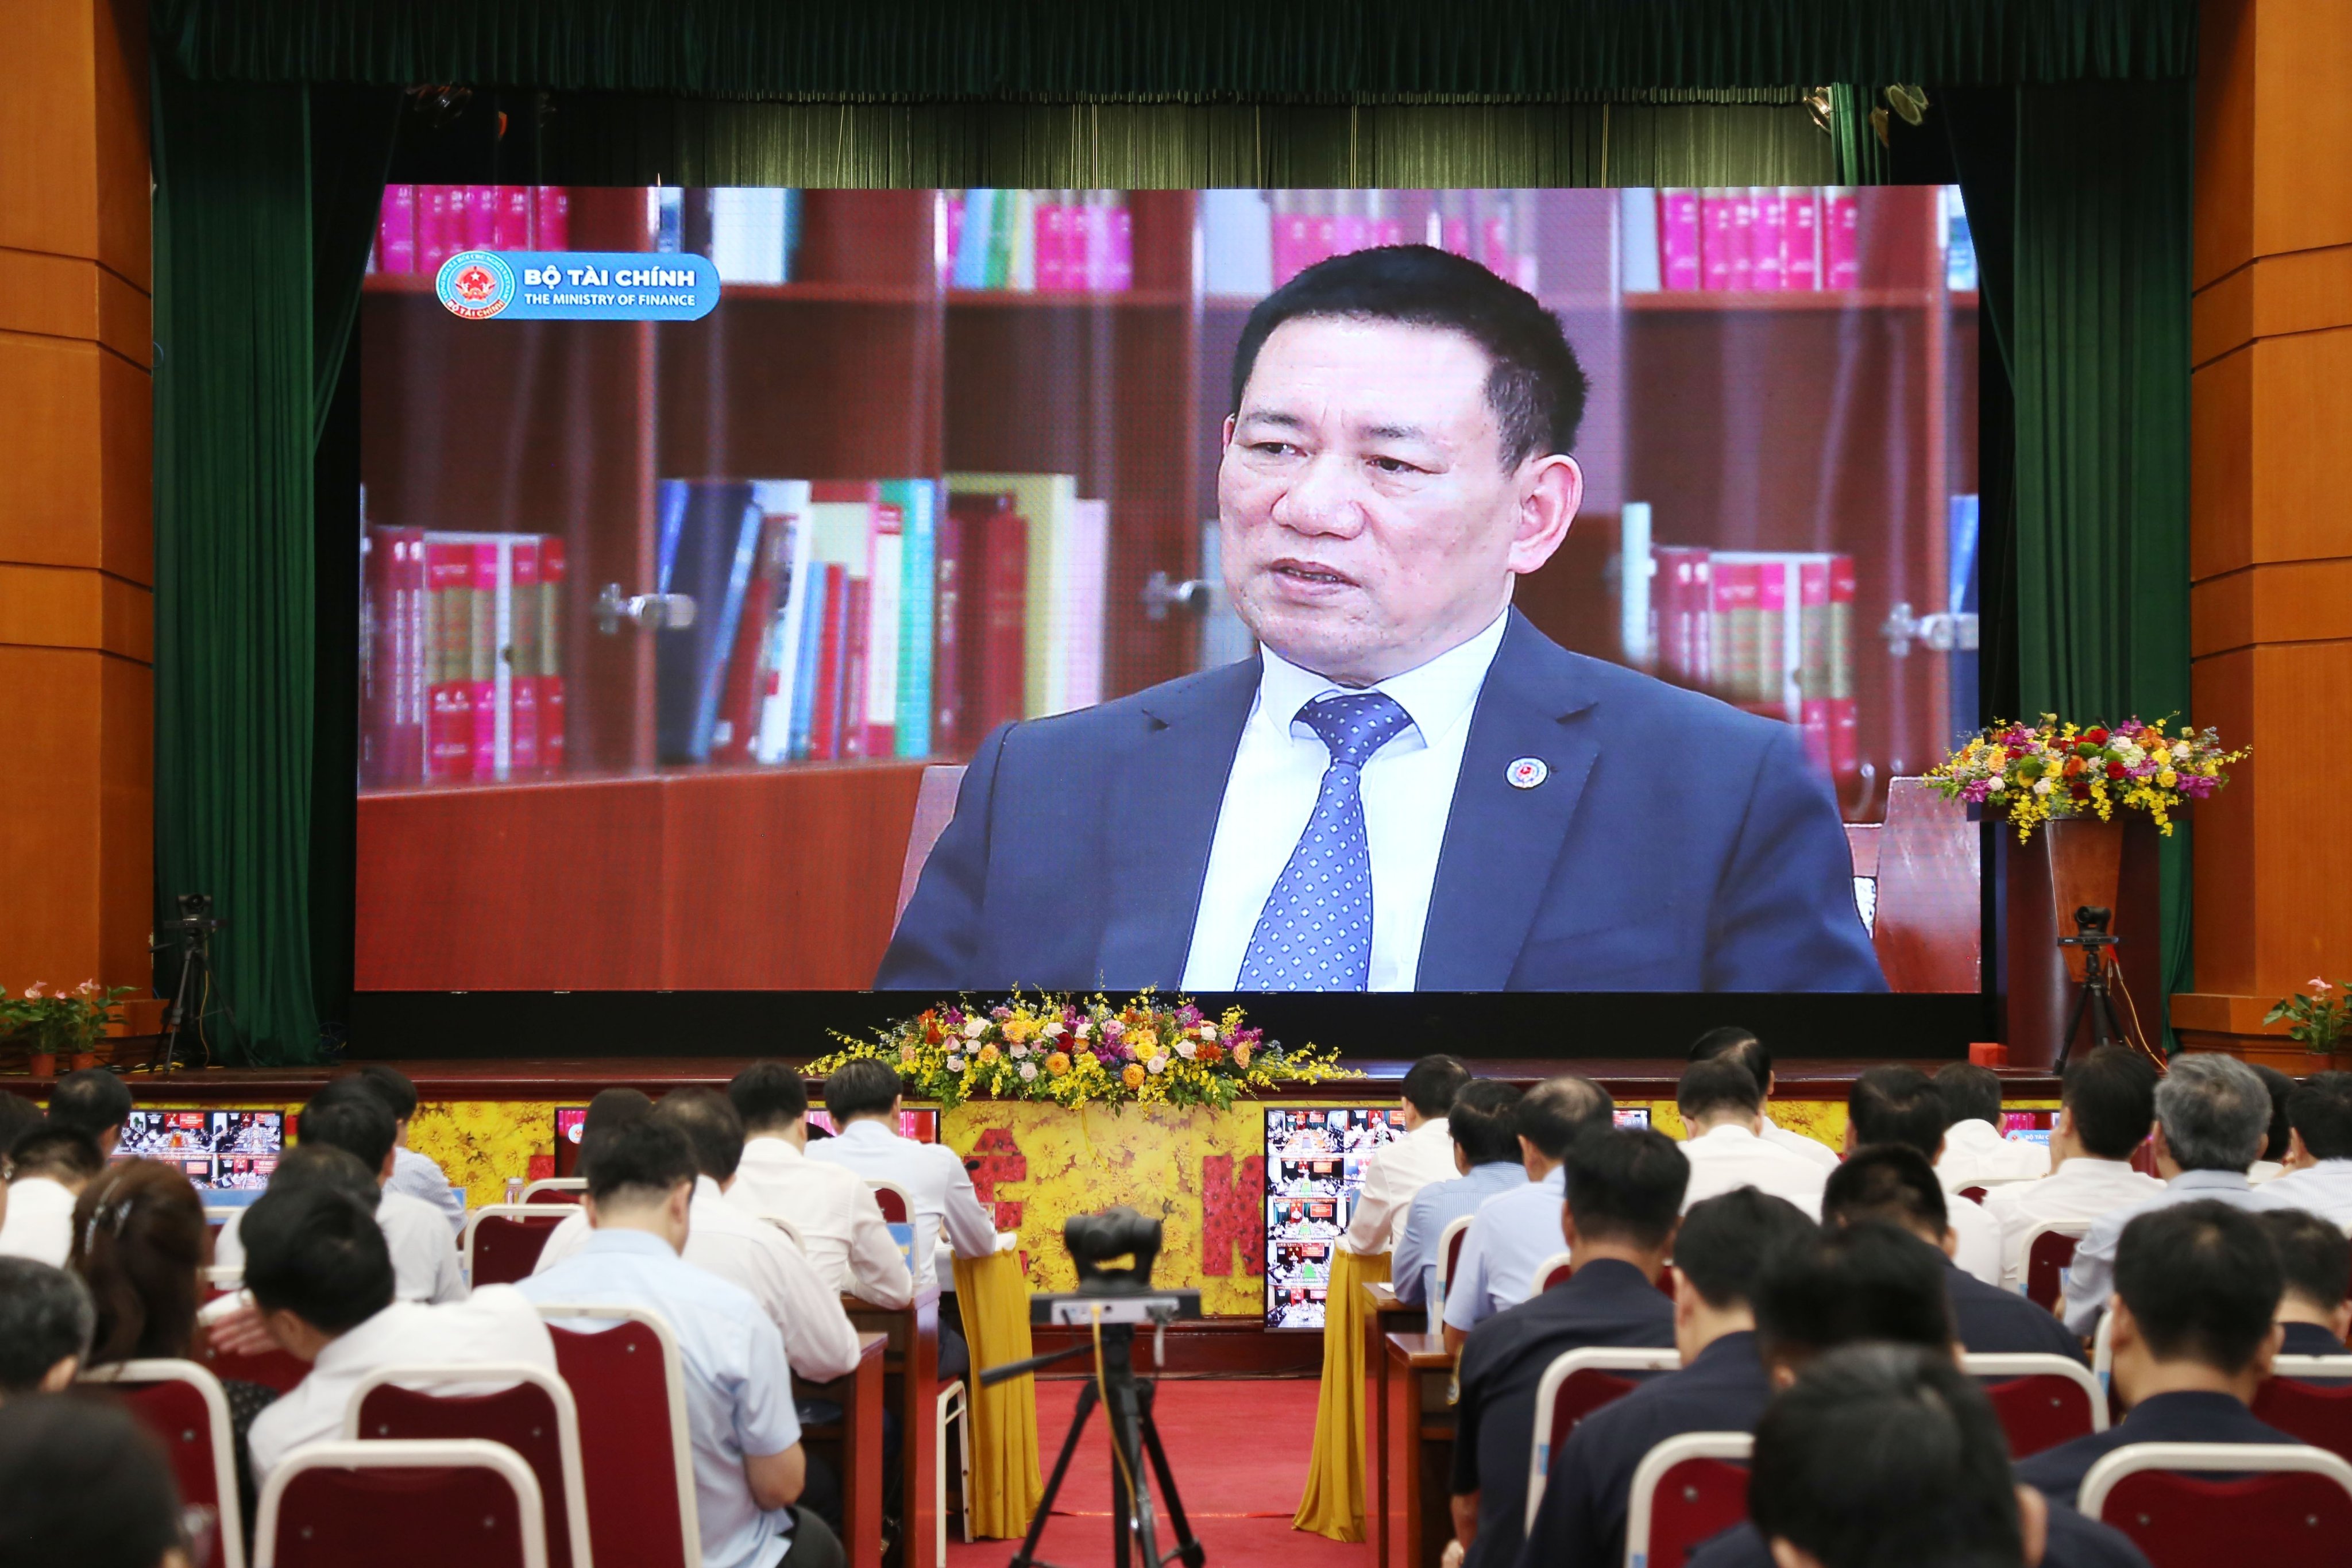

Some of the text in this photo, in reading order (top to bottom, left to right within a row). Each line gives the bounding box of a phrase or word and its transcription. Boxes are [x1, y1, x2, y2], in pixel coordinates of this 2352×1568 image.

[524, 265, 695, 289] BỘ TÀI CHÍNH
[524, 293, 696, 306] THE MINISTRY OF FINANCE
